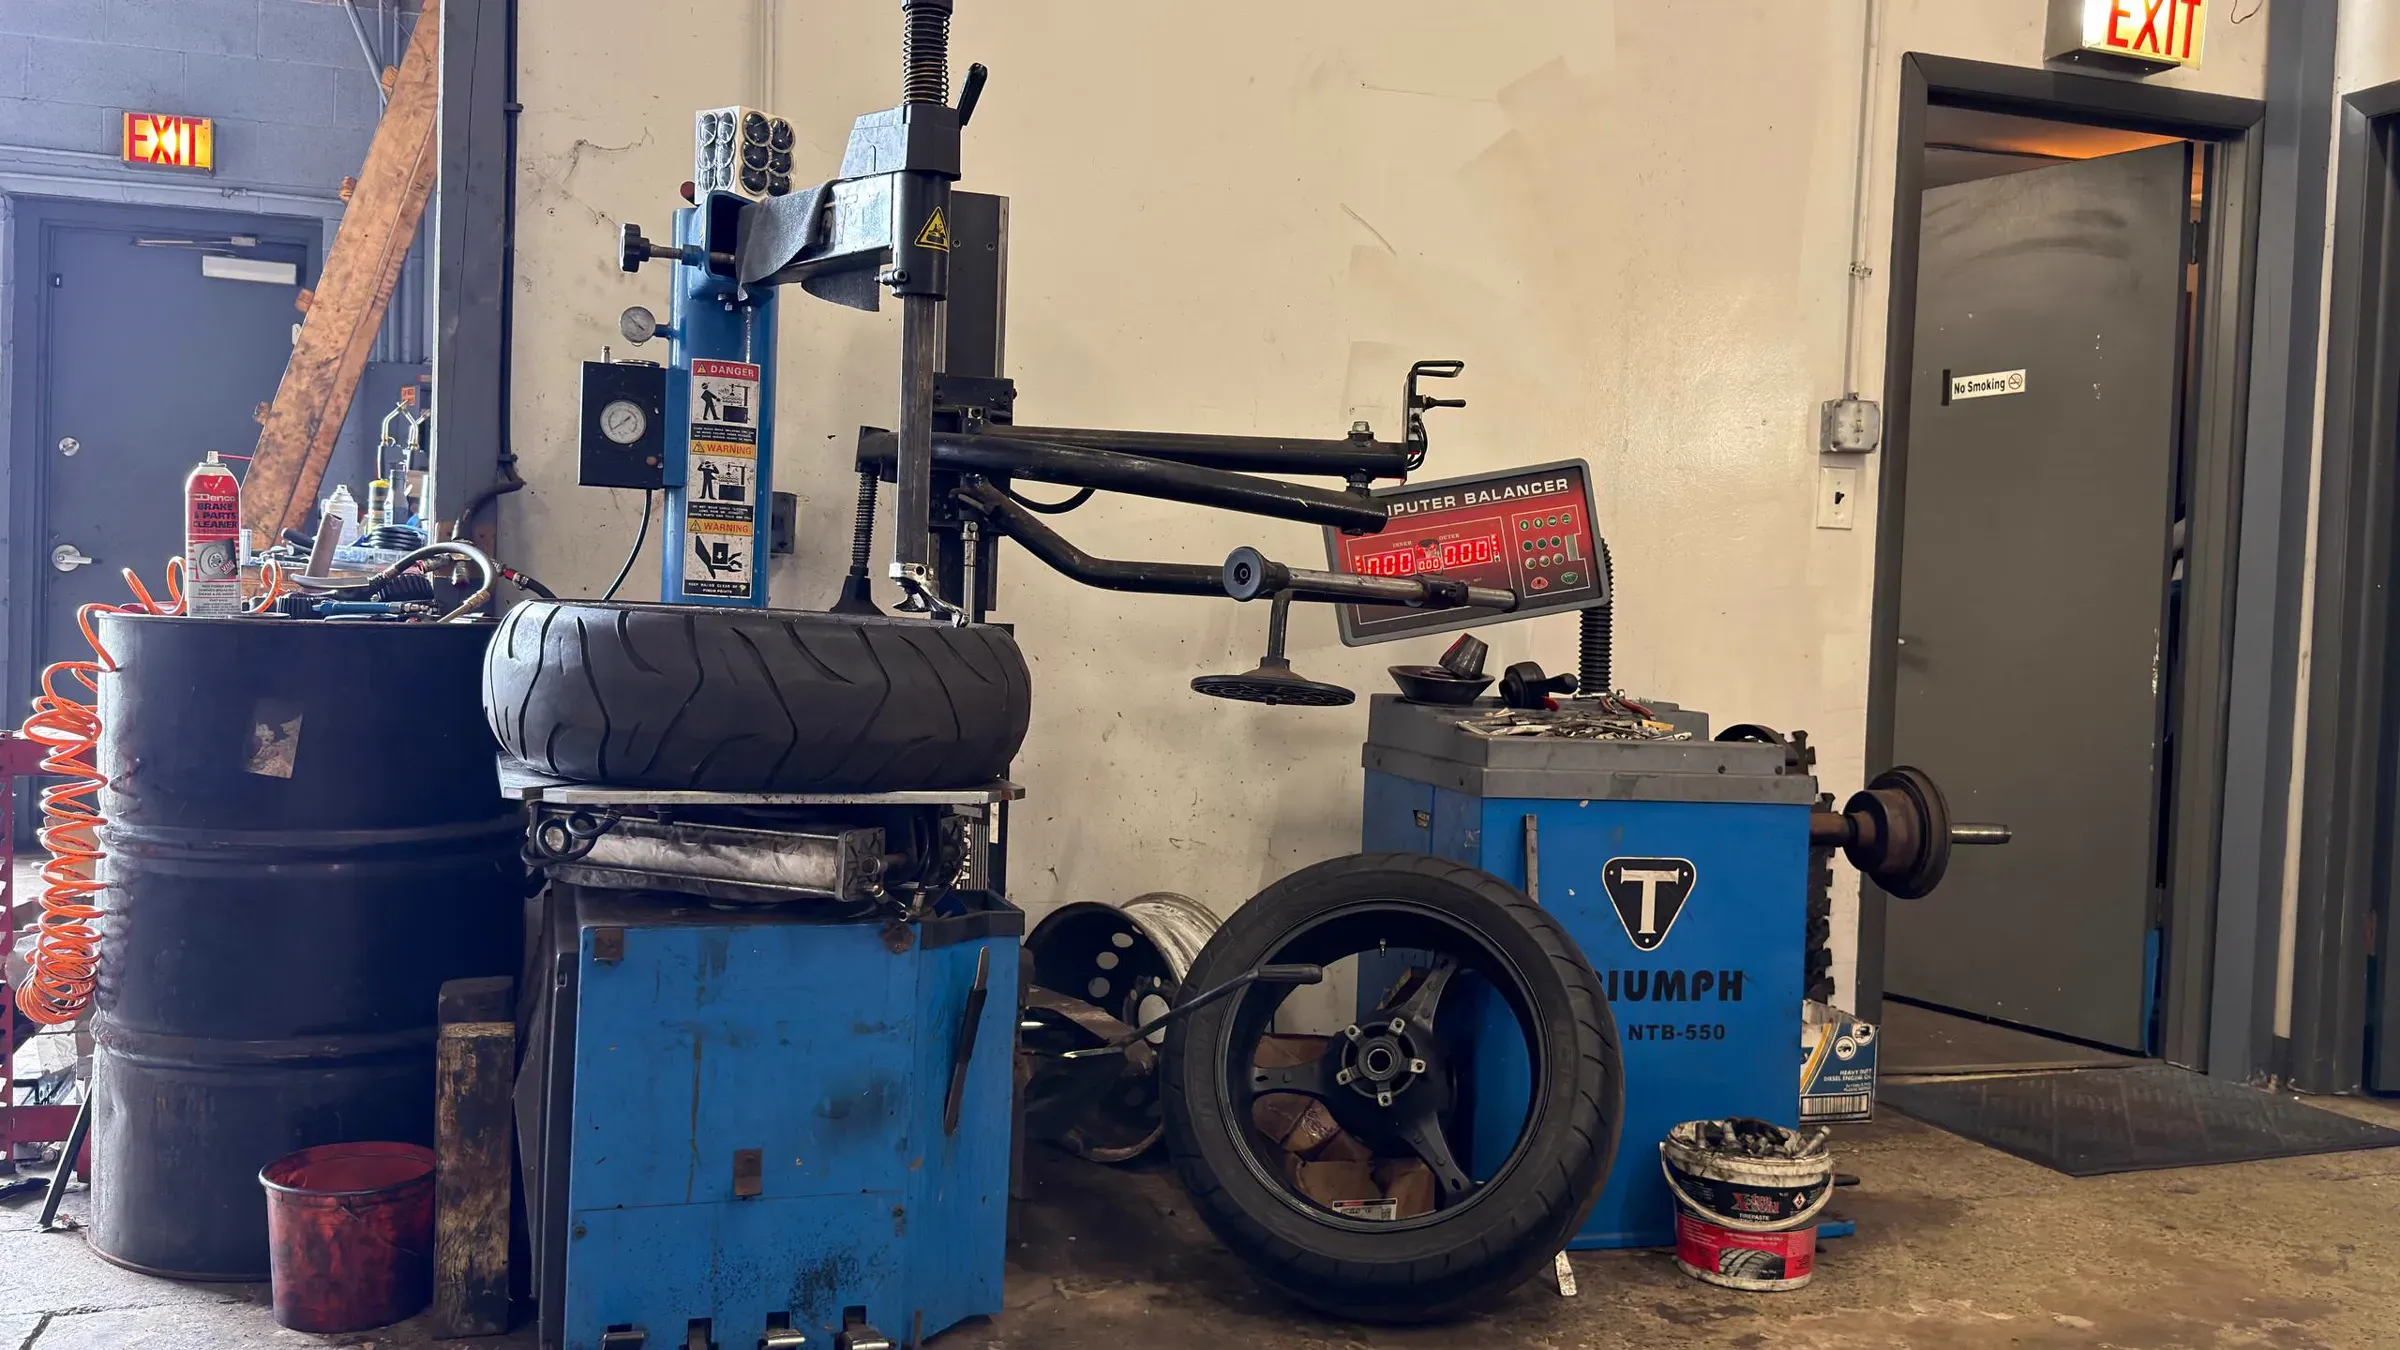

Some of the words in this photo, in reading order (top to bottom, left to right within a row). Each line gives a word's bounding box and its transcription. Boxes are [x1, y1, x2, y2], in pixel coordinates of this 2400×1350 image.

[2106, 0, 2201, 58] EXIT
[129, 113, 203, 167] EXIT
[710, 365, 754, 377] DANGER
[1954, 382, 1965, 395] No
[1967, 378, 2005, 392] Smoking
[707, 444, 752, 455] WARNING
[1387, 495, 1456, 516] PUTER
[1464, 478, 1568, 505] BALANCER
[197, 502, 233, 511] BRAKE
[203, 511, 237, 519] PARTS
[193, 520, 237, 528] CLEANER
[703, 522, 749, 533] WARNING
[1439, 533, 1460, 541] OUTER
[1392, 540, 1413, 549] INNER
[1444, 540, 1488, 566] 0.00
[1620, 866, 1680, 934] T
[1628, 1024, 1726, 1041] NTB-550
